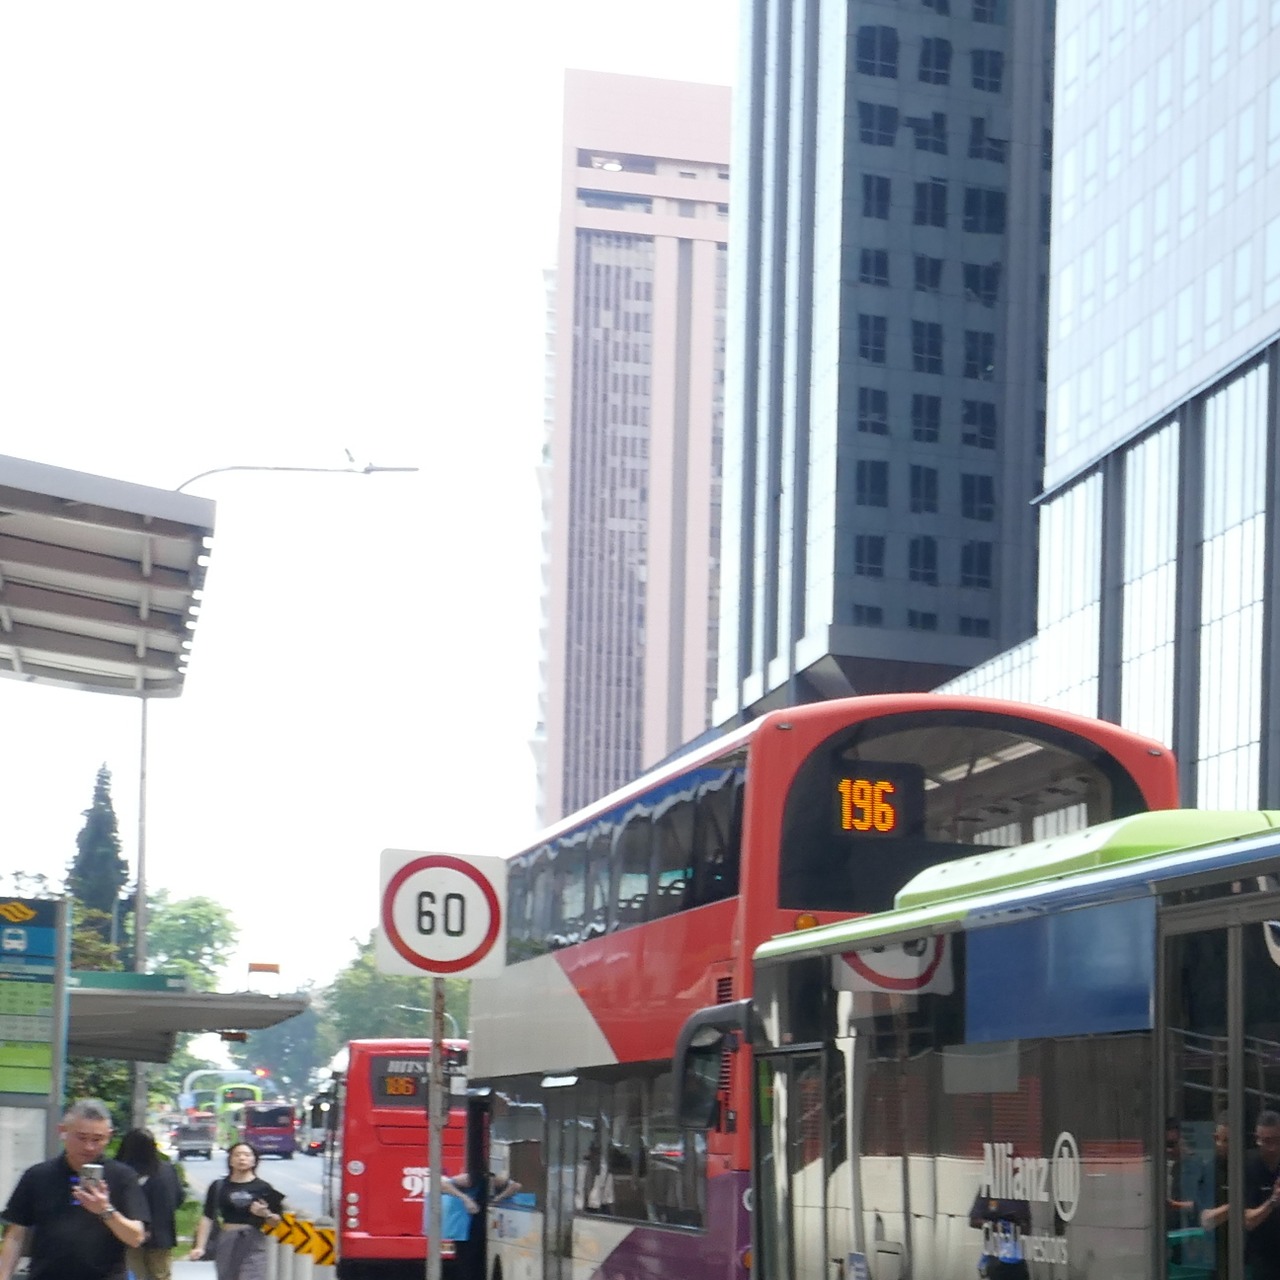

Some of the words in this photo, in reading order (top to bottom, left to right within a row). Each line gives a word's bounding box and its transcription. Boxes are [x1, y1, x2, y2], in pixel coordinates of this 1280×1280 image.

[837, 779, 895, 832] 196
[417, 891, 465, 937] 60
[979, 1142, 1049, 1202] Allianz
